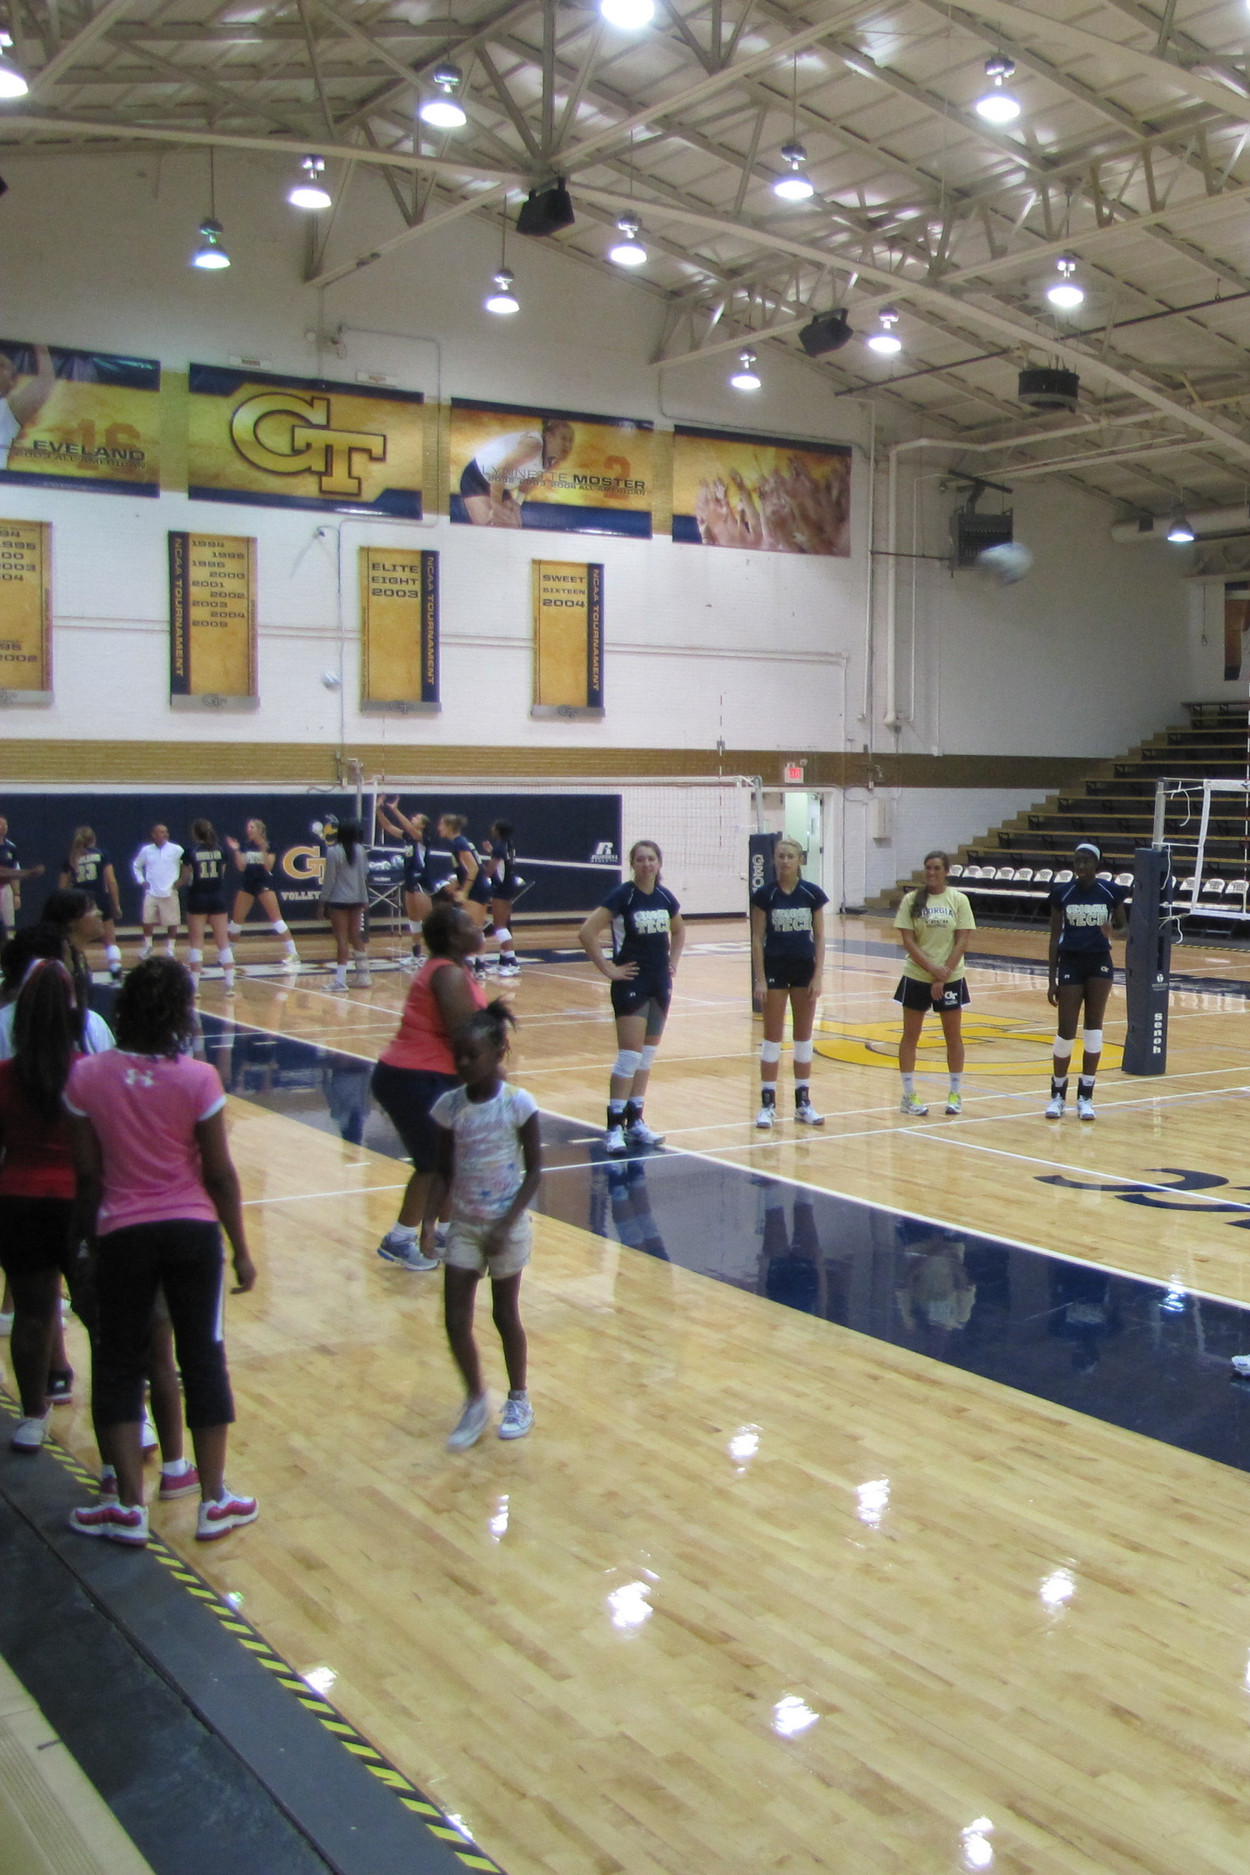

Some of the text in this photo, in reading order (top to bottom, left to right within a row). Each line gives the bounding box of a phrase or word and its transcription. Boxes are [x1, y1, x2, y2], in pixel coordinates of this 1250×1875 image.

[32, 439, 146, 462] EVELAND
[231, 391, 387, 497] GT
[573, 474, 646, 490] MOSTER
[372, 563, 419, 574] ELITE
[372, 575, 419, 586] EIGHT
[542, 574, 586, 584] SWEET
[592, 569, 600, 602] NCAA
[372, 588, 419, 598] 2003
[542, 587, 586, 596] SIXTEEN
[175, 538, 184, 677] NCAA TOURNAMENT
[542, 599, 586, 608] 2004
[427, 557, 435, 685] NCAA TOURNAMENT
[201, 861, 218, 878] 11
